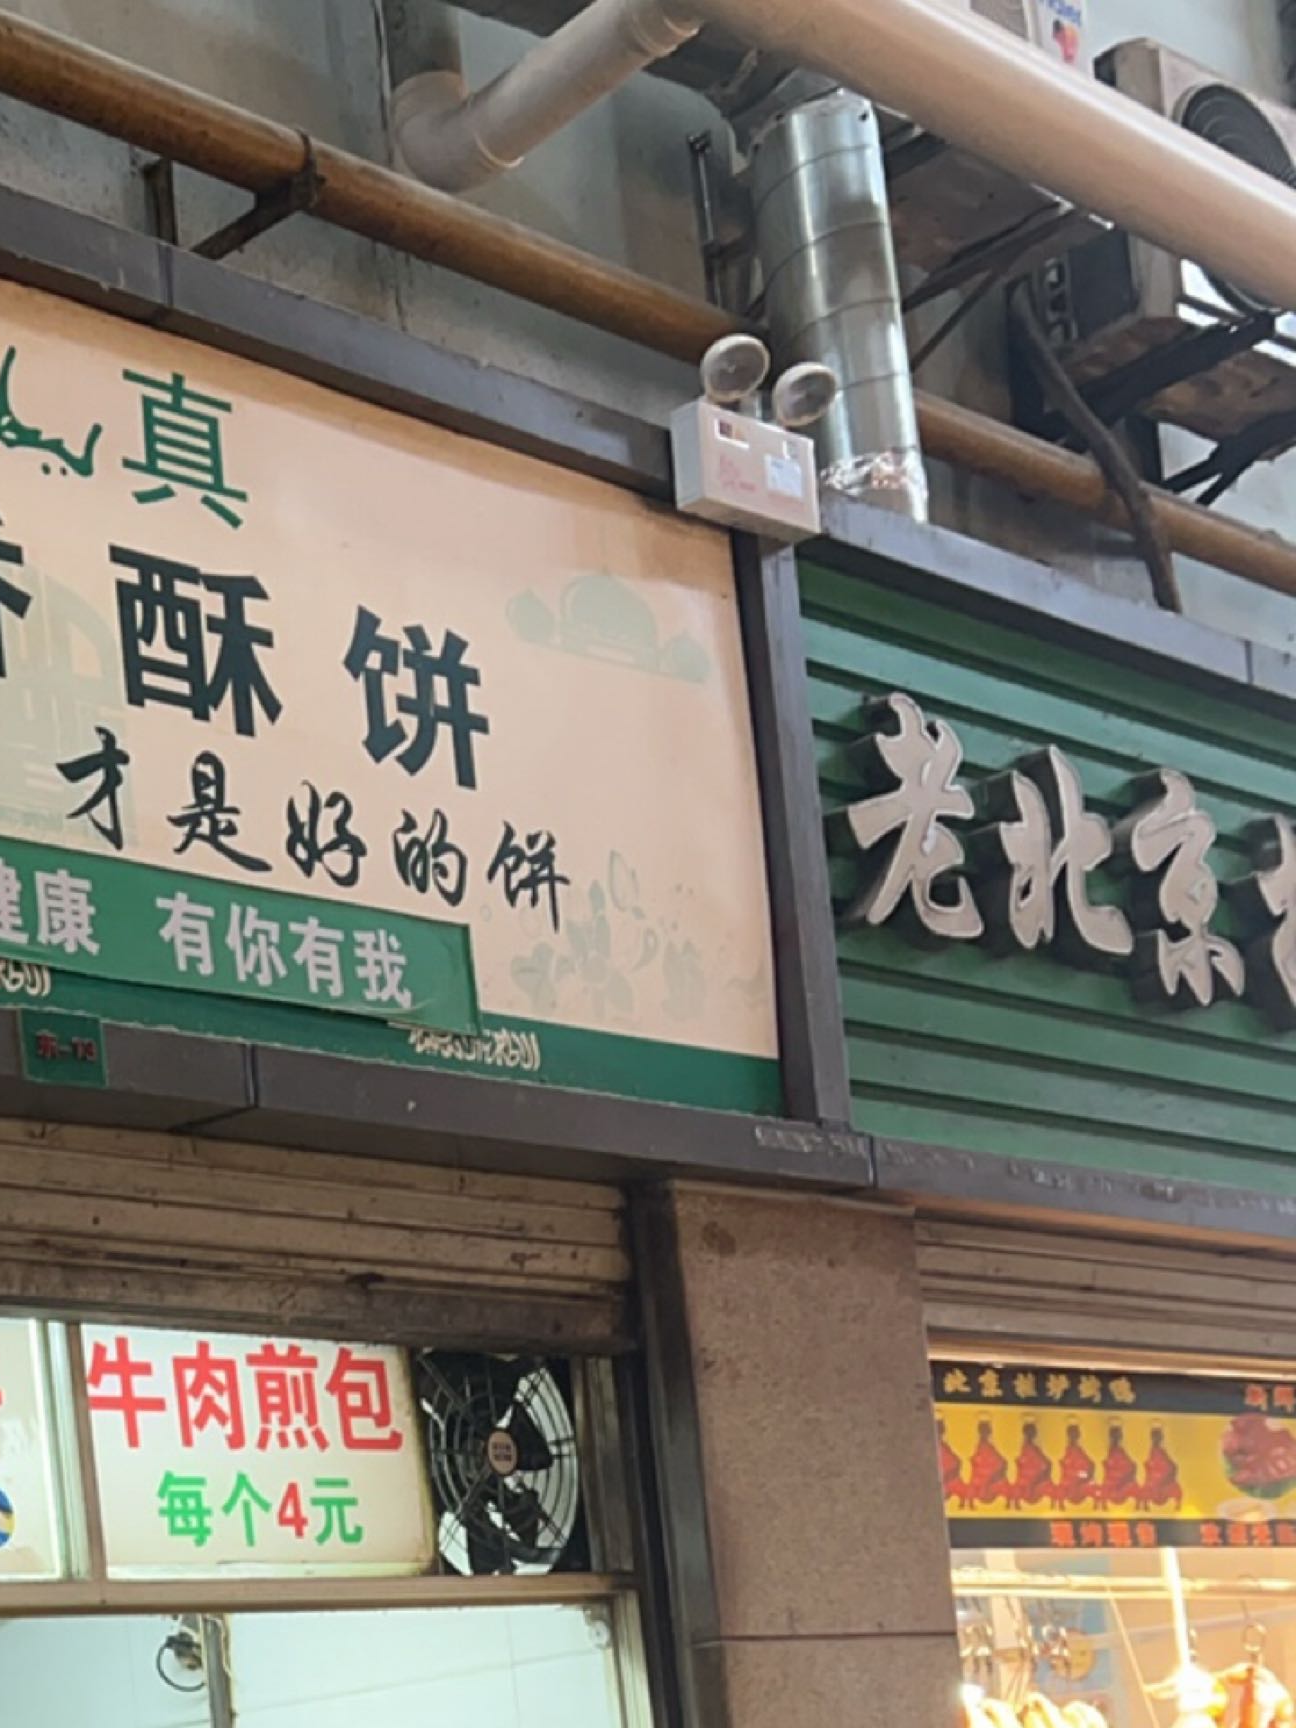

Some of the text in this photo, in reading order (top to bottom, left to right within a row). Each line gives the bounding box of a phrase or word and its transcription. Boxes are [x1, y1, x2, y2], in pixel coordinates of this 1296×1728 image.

[122, 369, 249, 528] 真
[56, 727, 570, 932] 才是好的饼
[156, 890, 413, 1008] 有你有我
[87, 1336, 404, 1452] 牛肉煎包
[157, 1471, 364, 1548] 每个4元
